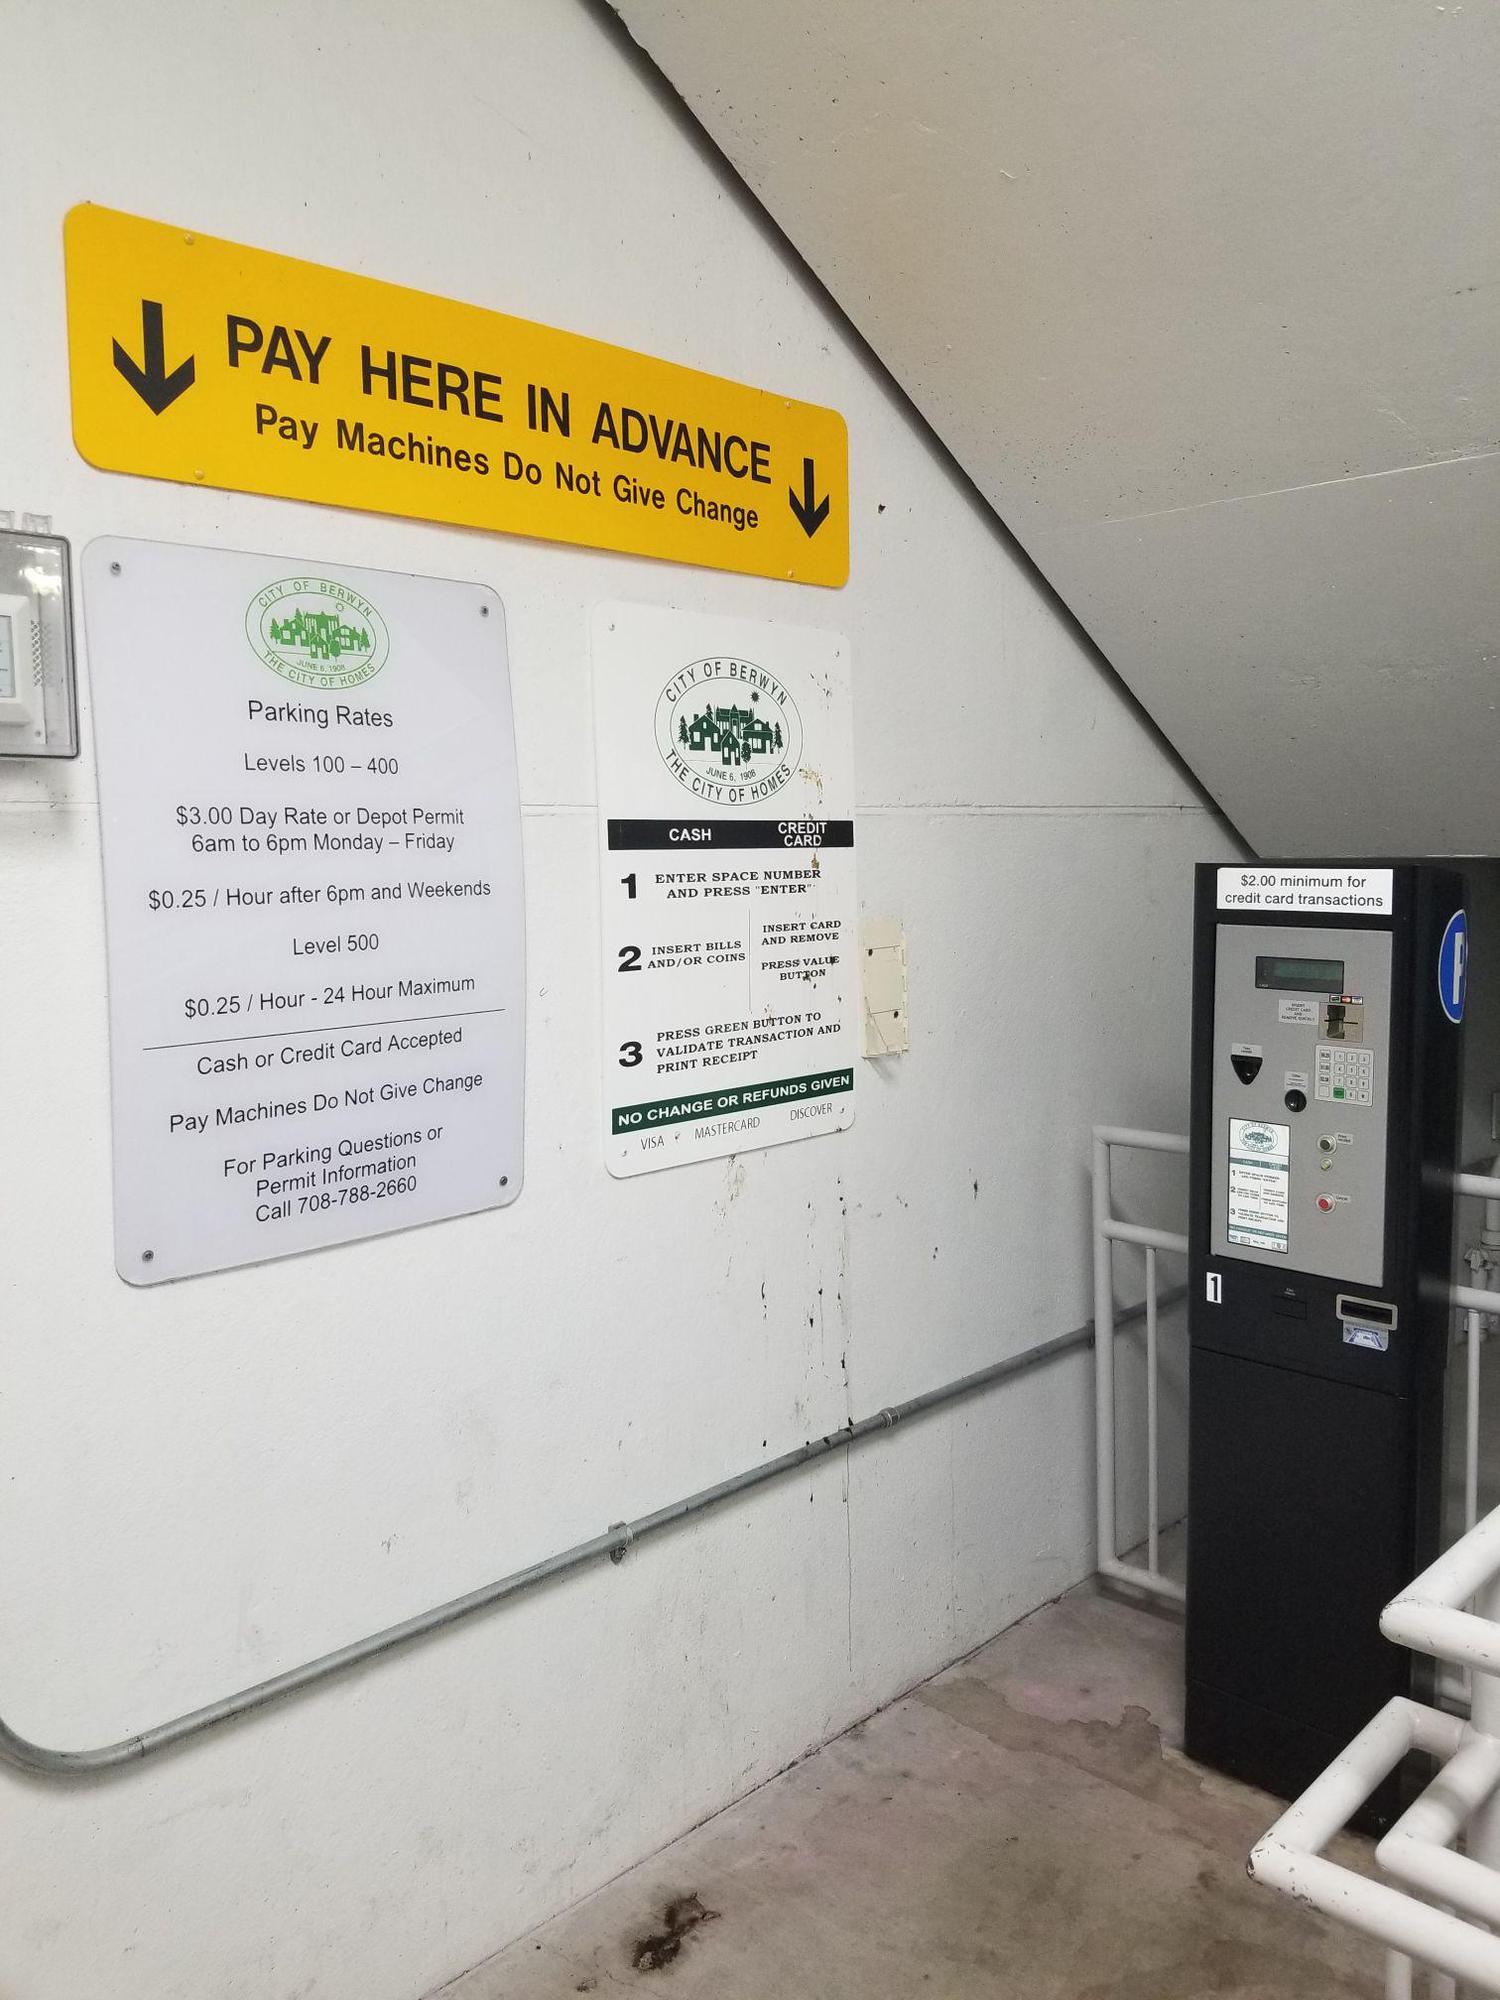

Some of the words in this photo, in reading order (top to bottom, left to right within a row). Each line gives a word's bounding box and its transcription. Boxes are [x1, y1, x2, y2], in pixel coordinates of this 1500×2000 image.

[227, 315, 331, 386] PAY
[361, 345, 503, 424] HERE
[527, 384, 570, 438] IN
[592, 399, 772, 485] ADVANCE
[256, 404, 318, 451] Pay
[338, 418, 490, 476] Machines
[505, 451, 543, 485] Do
[556, 462, 601, 497] Not
[612, 474, 665, 511] Give
[676, 487, 760, 530] Change
[259, 585, 284, 608] CITY
[293, 581, 310, 591] OF
[320, 583, 373, 617] BERWYN
[264, 650, 286, 672] THE
[289, 670, 315, 684] CITY
[320, 677, 335, 687] OF
[340, 664, 375, 686] HOMES
[297, 660, 317, 671] JUNE
[666, 669, 696, 703] CITY
[704, 662, 722, 677] OF
[730, 663, 788, 706] BERWYN
[249, 700, 329, 729] Parking
[336, 705, 394, 728] Rates
[245, 753, 306, 773] Levels
[313, 756, 345, 774] 100
[368, 758, 399, 775] 400
[665, 749, 687, 782] THE
[692, 777, 723, 801] CITY
[729, 789, 745, 803] OF
[751, 764, 791, 800] HOMES
[706, 767, 728, 780] JUNE
[740, 769, 756, 780] 1908
[176, 806, 233, 827] $3.00
[240, 807, 278, 830] Day
[284, 808, 328, 826] Rate
[334, 812, 351, 825] or
[357, 809, 407, 829] Depot
[413, 809, 464, 825] Permit
[778, 822, 827, 834] CREDIT
[192, 834, 235, 852] 6am
[242, 835, 260, 852] to
[267, 834, 307, 857] 6pm
[314, 834, 383, 855] Monday
[405, 834, 455, 852] Friday
[669, 828, 712, 841] CASH
[784, 835, 822, 846] CARD
[621, 874, 637, 899] 1
[655, 873, 707, 884] ENTER
[712, 872, 758, 882] SPACE
[764, 870, 821, 880] NUMBER
[1241, 875, 1276, 887] $2.00
[1280, 875, 1343, 888] minimum
[1347, 876, 1367, 888] for
[148, 890, 207, 911] $0.25
[213, 890, 219, 908] /
[226, 887, 273, 906] Hour
[279, 885, 320, 904] after
[327, 885, 365, 906] 6pm
[371, 883, 401, 900] and
[407, 880, 491, 899] Weekends
[667, 889, 698, 899] AND
[704, 886, 750, 898] PRESS
[1225, 892, 1261, 904] credit
[1265, 892, 1294, 905] card
[1298, 894, 1383, 907] transactions
[763, 923, 806, 933] INSERT
[810, 920, 842, 930] CARD
[293, 936, 340, 956] Level
[347, 934, 379, 952] 500
[652, 944, 702, 955] INSERT
[706, 941, 742, 951] BILLS
[762, 936, 786, 946] AND
[791, 933, 839, 943] REMOVE
[618, 946, 642, 973] 2
[648, 957, 702, 969] AND/OR
[707, 953, 746, 964] COINS
[761, 960, 800, 970] PRESS
[803, 956, 840, 966] VALUE
[780, 969, 826, 981] BUTTON
[185, 996, 241, 1019] $0.25
[247, 994, 253, 1013] /
[260, 991, 306, 1011] Hour
[324, 989, 345, 1005] 24
[352, 984, 393, 1002] Hour
[399, 976, 475, 997] Maximum
[657, 1028, 700, 1042] PRESS
[705, 1021, 749, 1036] GREEN
[753, 1015, 802, 1030] BUTTON
[805, 1012, 822, 1022] TO
[197, 1052, 248, 1075] Cash
[255, 1054, 274, 1068] or
[280, 1042, 335, 1065] Credit
[341, 1037, 382, 1057] Card
[388, 1027, 462, 1053] Accepted
[657, 1040, 724, 1058] VALIDATE
[728, 1028, 814, 1048] TRANSACTION
[817, 1024, 841, 1036] AND
[619, 1041, 643, 1067] 3
[657, 1060, 698, 1074] PRINT
[702, 1050, 758, 1067] RECEIPT
[170, 1113, 209, 1133] Pay
[217, 1099, 307, 1126] Machines
[314, 1093, 338, 1112] Do
[345, 1087, 375, 1107] Not
[380, 1083, 417, 1102] Give
[422, 1072, 483, 1095] Change
[618, 1112, 643, 1126] NO
[647, 1100, 713, 1121] CHANGE
[717, 1095, 739, 1108] OR
[743, 1083, 807, 1103] REFUNDS
[811, 1075, 850, 1091] GIVEN
[641, 1136, 665, 1150] VISA
[694, 1117, 760, 1140] MASTERCARD
[790, 1103, 833, 1121] DISCOVER
[224, 1157, 256, 1178] For
[263, 1143, 332, 1171] Parking
[338, 1128, 422, 1156] Questions
[427, 1125, 443, 1140] or
[256, 1173, 316, 1197] Permit
[323, 1155, 417, 1185] Information
[255, 1201, 292, 1222] Call
[298, 1175, 417, 1214] 708-788-2660
[1210, 1275, 1219, 1302] 1
